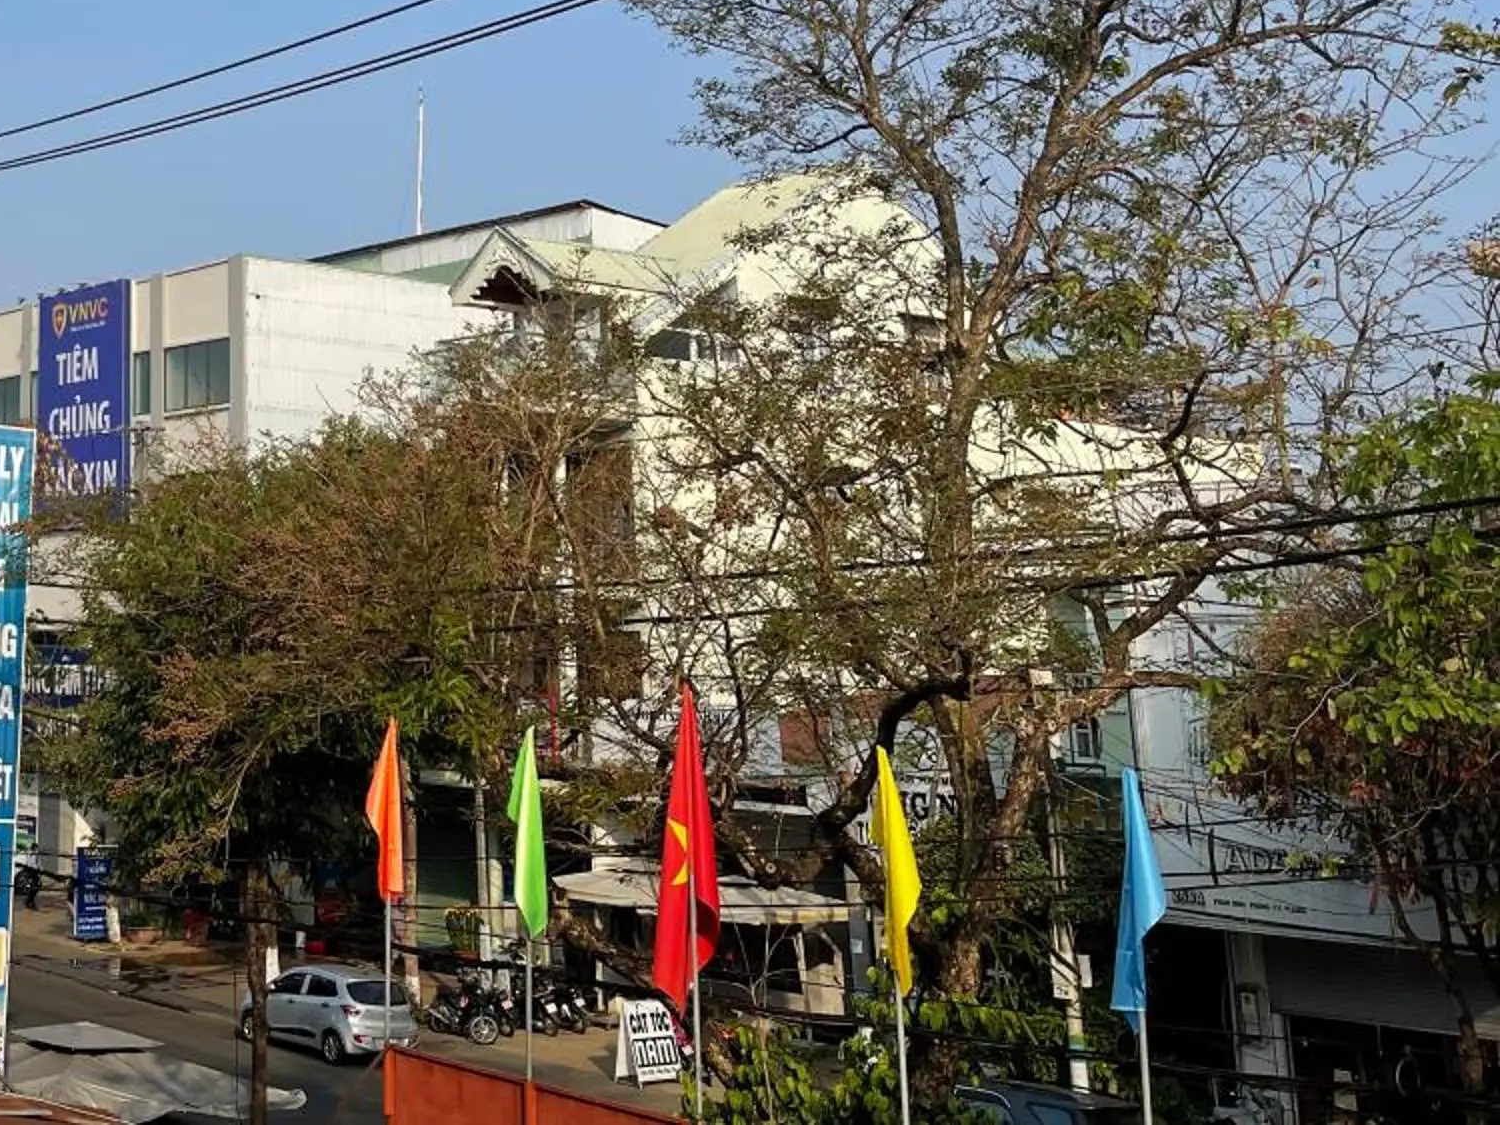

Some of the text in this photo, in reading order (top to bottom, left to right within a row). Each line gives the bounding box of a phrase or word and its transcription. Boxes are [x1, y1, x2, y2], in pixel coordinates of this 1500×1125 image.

[69, 297, 108, 323] VNVC
[55, 343, 98, 385] TIÊM
[50, 395, 111, 440] CHỦNG
